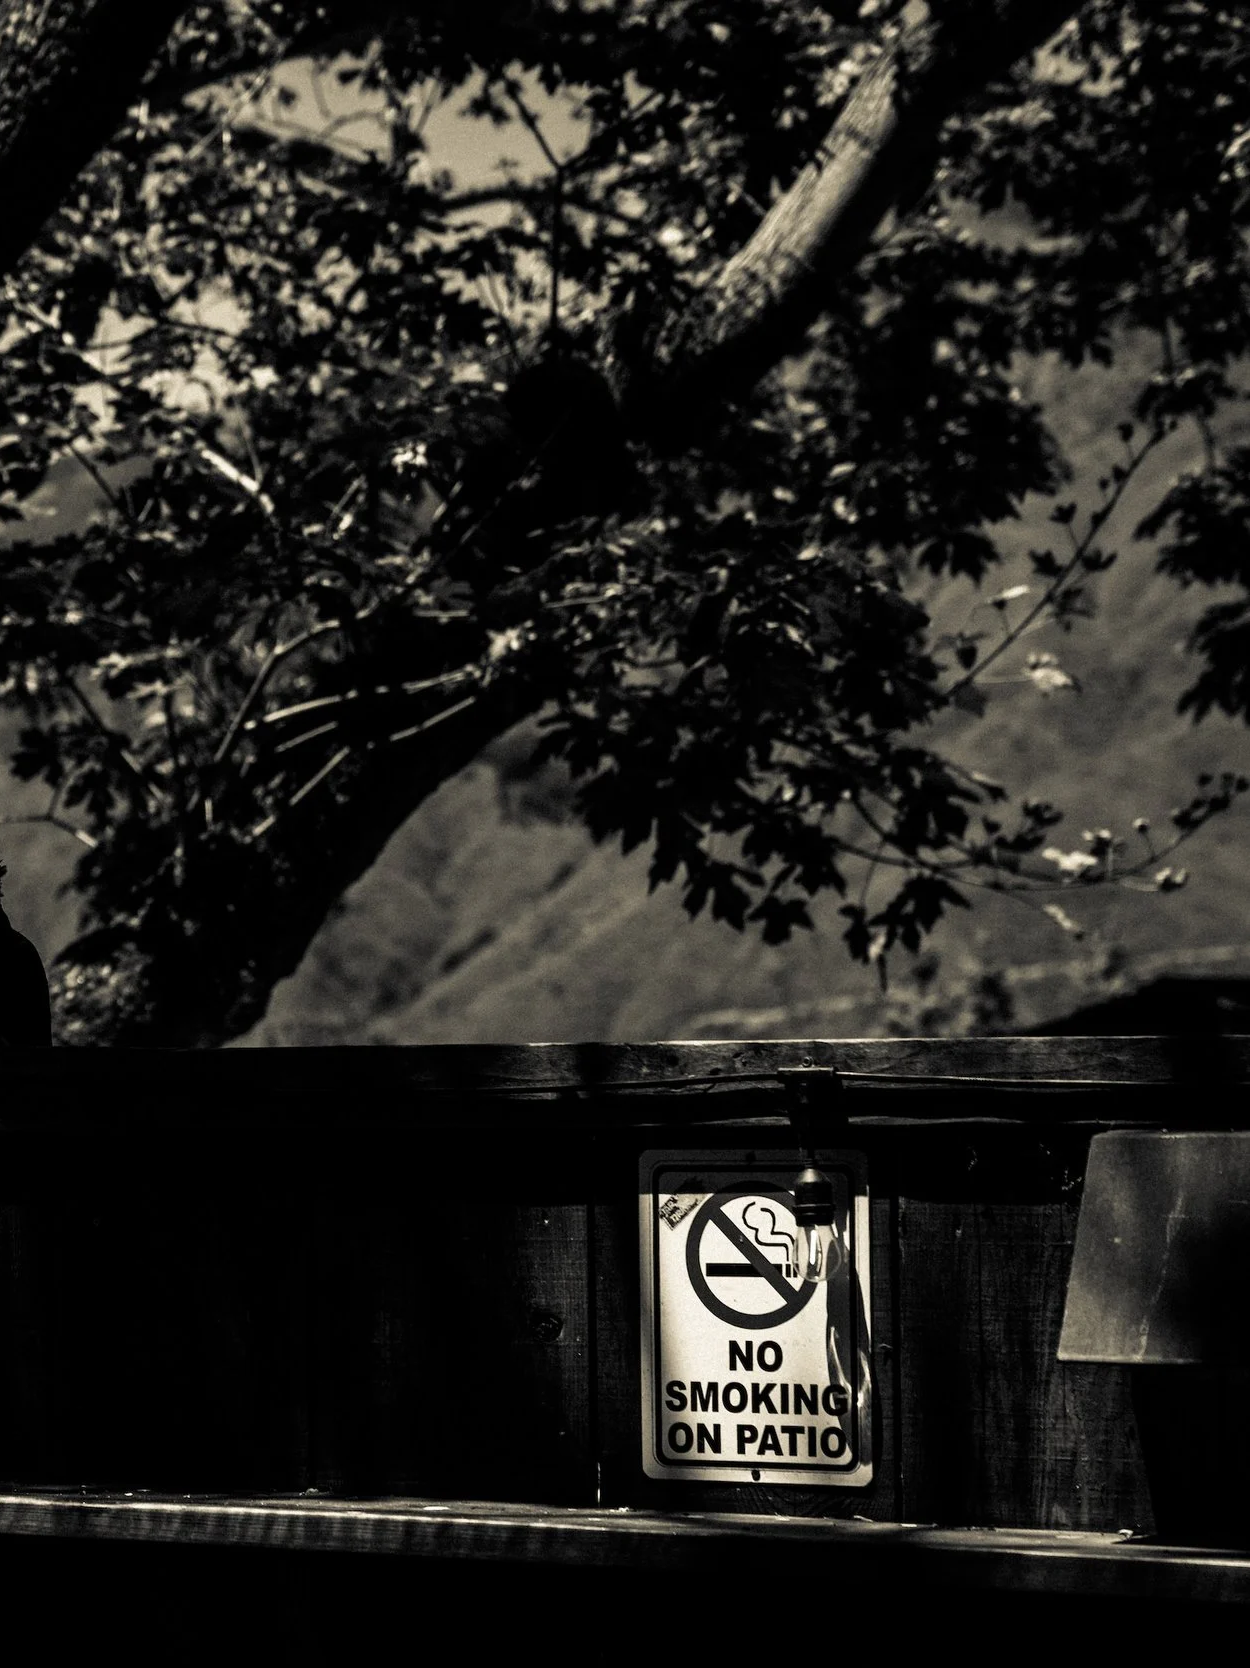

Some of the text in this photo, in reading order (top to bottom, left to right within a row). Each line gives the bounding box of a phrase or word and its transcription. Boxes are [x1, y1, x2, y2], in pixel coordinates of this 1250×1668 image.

[729, 1340, 783, 1371] NO
[665, 1381, 849, 1416] SMOKING
[668, 1422, 847, 1458] ON PATIO
